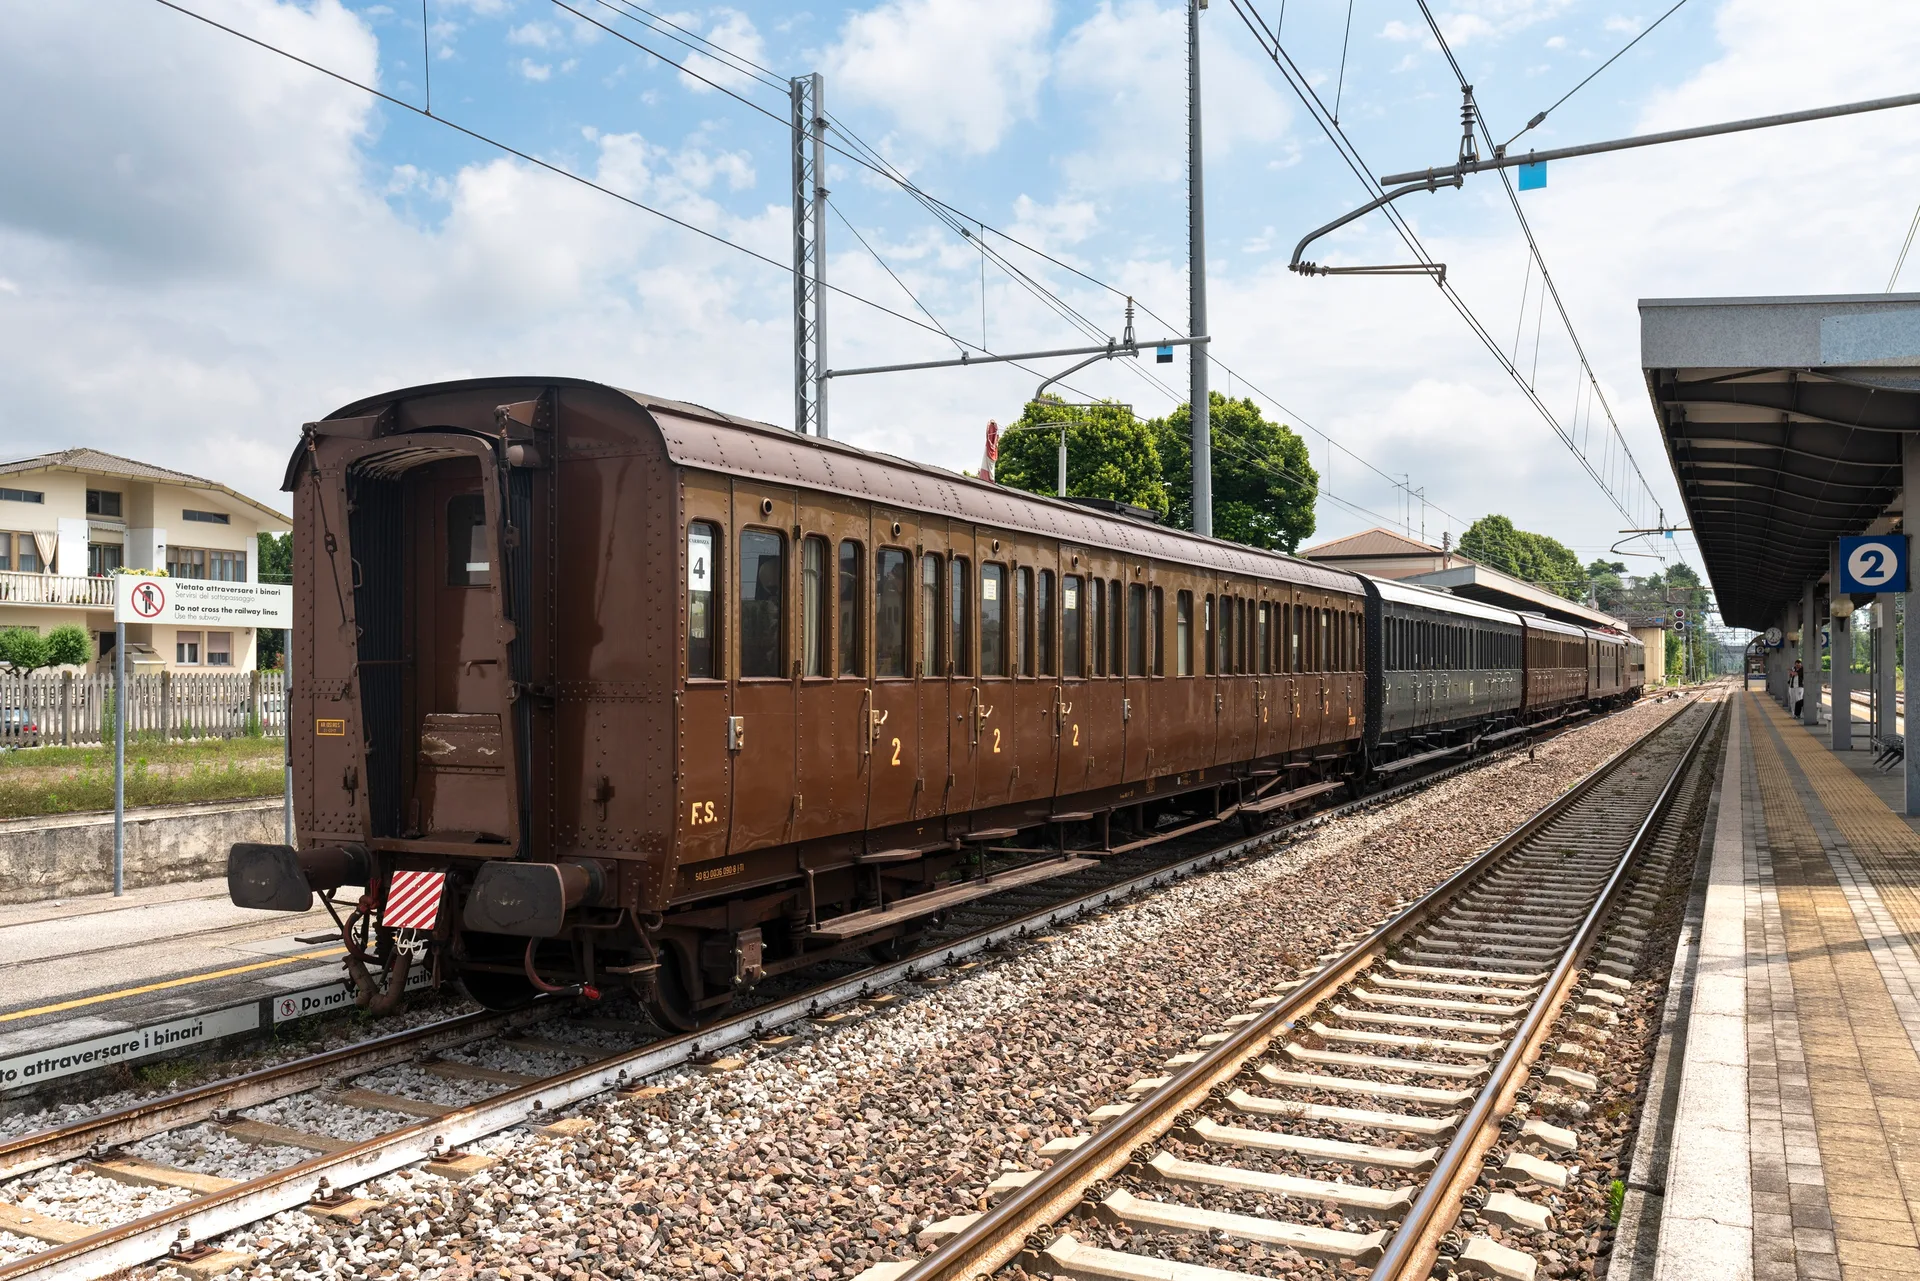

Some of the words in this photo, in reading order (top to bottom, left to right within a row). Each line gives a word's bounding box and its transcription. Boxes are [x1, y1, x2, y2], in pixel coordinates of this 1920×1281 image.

[693, 557, 705, 579] 4
[1860, 550, 1884, 578] 2
[175, 583, 204, 592] Vietato
[206, 585, 254, 594] attraversare
[259, 588, 281, 596] binari
[175, 591, 198, 599] Servirsi
[199, 592, 209, 600] del
[210, 594, 255, 603] sottopassaggio
[175, 604, 185, 612] Do
[187, 605, 200, 613] not
[234, 607, 261, 616] railway
[262, 608, 278, 616] lines
[175, 612, 186, 620] Use
[198, 614, 221, 622] subway
[993, 728, 1000, 753] 2
[1072, 724, 1079, 746] 2
[891, 737, 901, 766] 2
[691, 801, 718, 826] F.S.
[695, 872, 703, 881] 50
[301, 997, 320, 1011] Do
[324, 990, 346, 1006] not
[407, 970, 432, 985] rail
[23, 1038, 140, 1077] attraversare
[144, 1034, 149, 1048] i
[154, 1022, 203, 1046] binari
